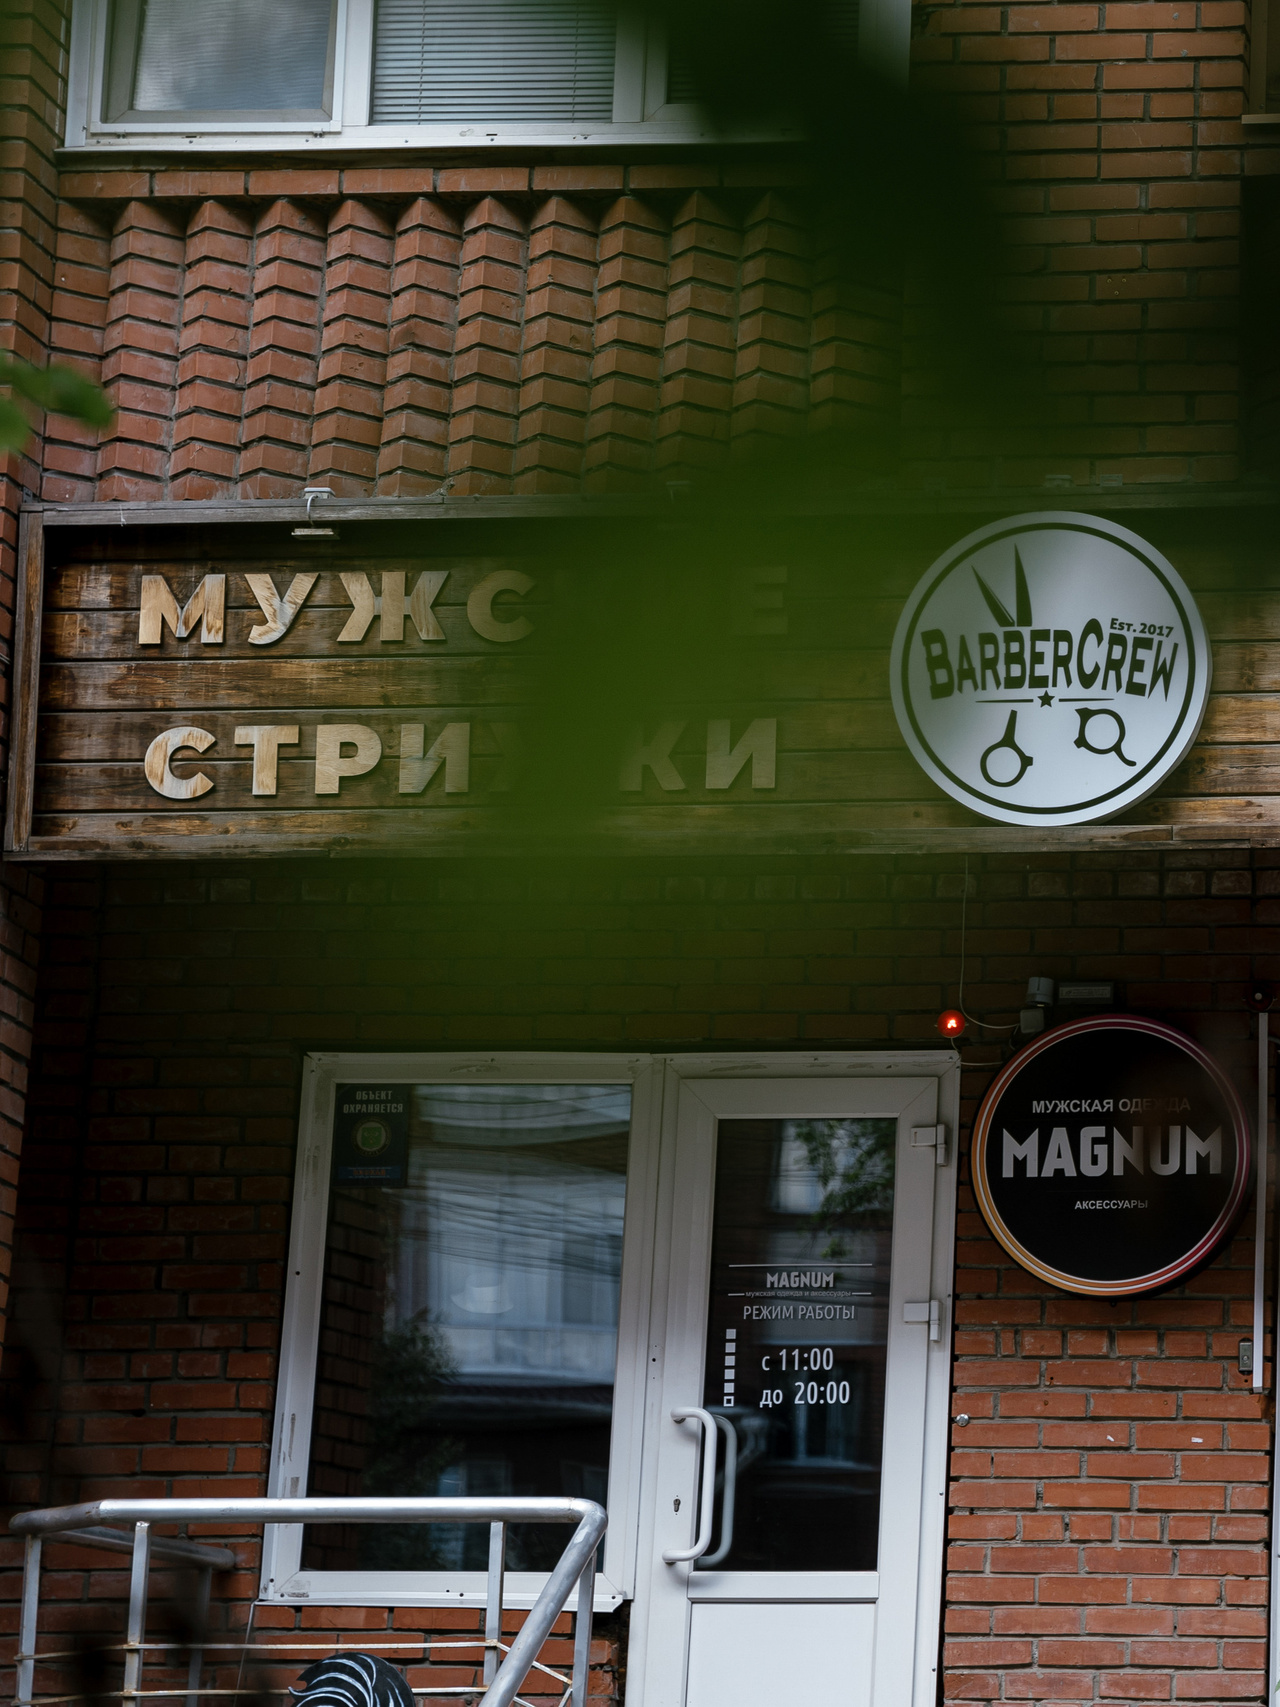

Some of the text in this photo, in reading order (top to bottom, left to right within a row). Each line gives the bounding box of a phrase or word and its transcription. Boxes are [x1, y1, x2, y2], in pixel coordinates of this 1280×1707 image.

[138, 566, 788, 646] МУЖСЕ
[1139, 622, 1174, 638] 2017
[144, 717, 777, 800] СТРИКИ
[356, 1090, 393, 1101] ОБЪЕКТ
[343, 1103, 404, 1114] ОХРАНЯЕТСЯ
[1032, 1099, 1114, 1114] МУЖСКАЯ
[1002, 1125, 1222, 1178] MAGNUM
[1074, 1199, 1149, 1210] АКСЕССУАРЫ
[766, 1272, 835, 1288] MAGNUM
[746, 1290, 775, 1299] мужская
[743, 1305, 855, 1320] РЕЖИМ РАБОТЫ
[761, 1348, 834, 1371] с 11:00
[759, 1381, 850, 1408] до 20:00
